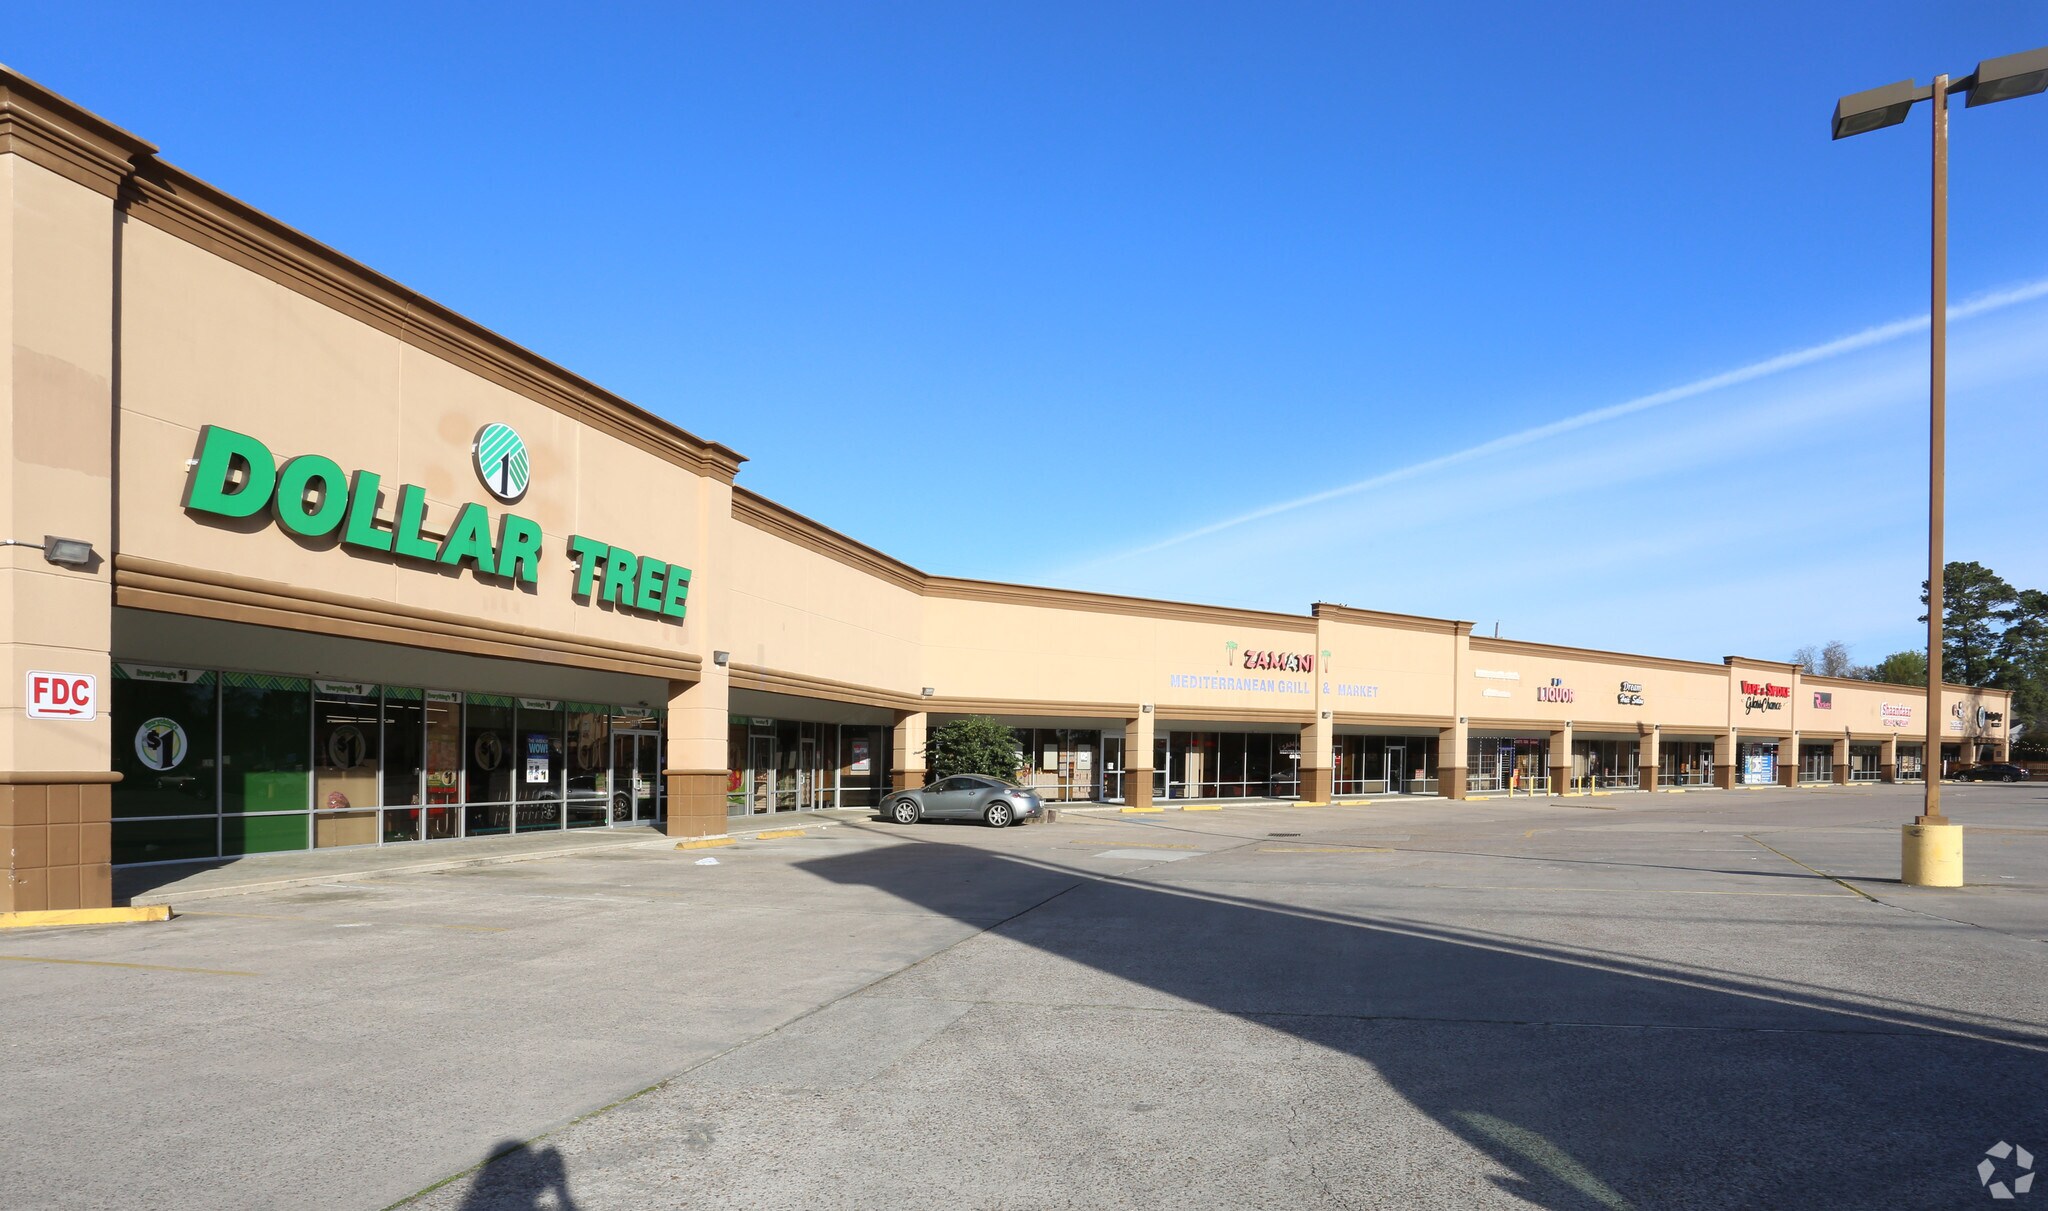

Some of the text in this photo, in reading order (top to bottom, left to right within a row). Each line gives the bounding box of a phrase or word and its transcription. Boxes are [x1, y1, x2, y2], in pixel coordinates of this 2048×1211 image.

[186, 425, 692, 618] DOLLAR TREE
[34, 676, 89, 706] FDC
[1170, 674, 1379, 698] MEDITERRANEAN GRILL & MARKET
[1537, 686, 1576, 703] LIQUOR
[1620, 681, 1643, 692] Dream
[1740, 680, 1760, 695] VAPE
[1765, 683, 1790, 698] SMOKE
[147, 729, 174, 769] $1
[528, 743, 549, 754] WOW!
